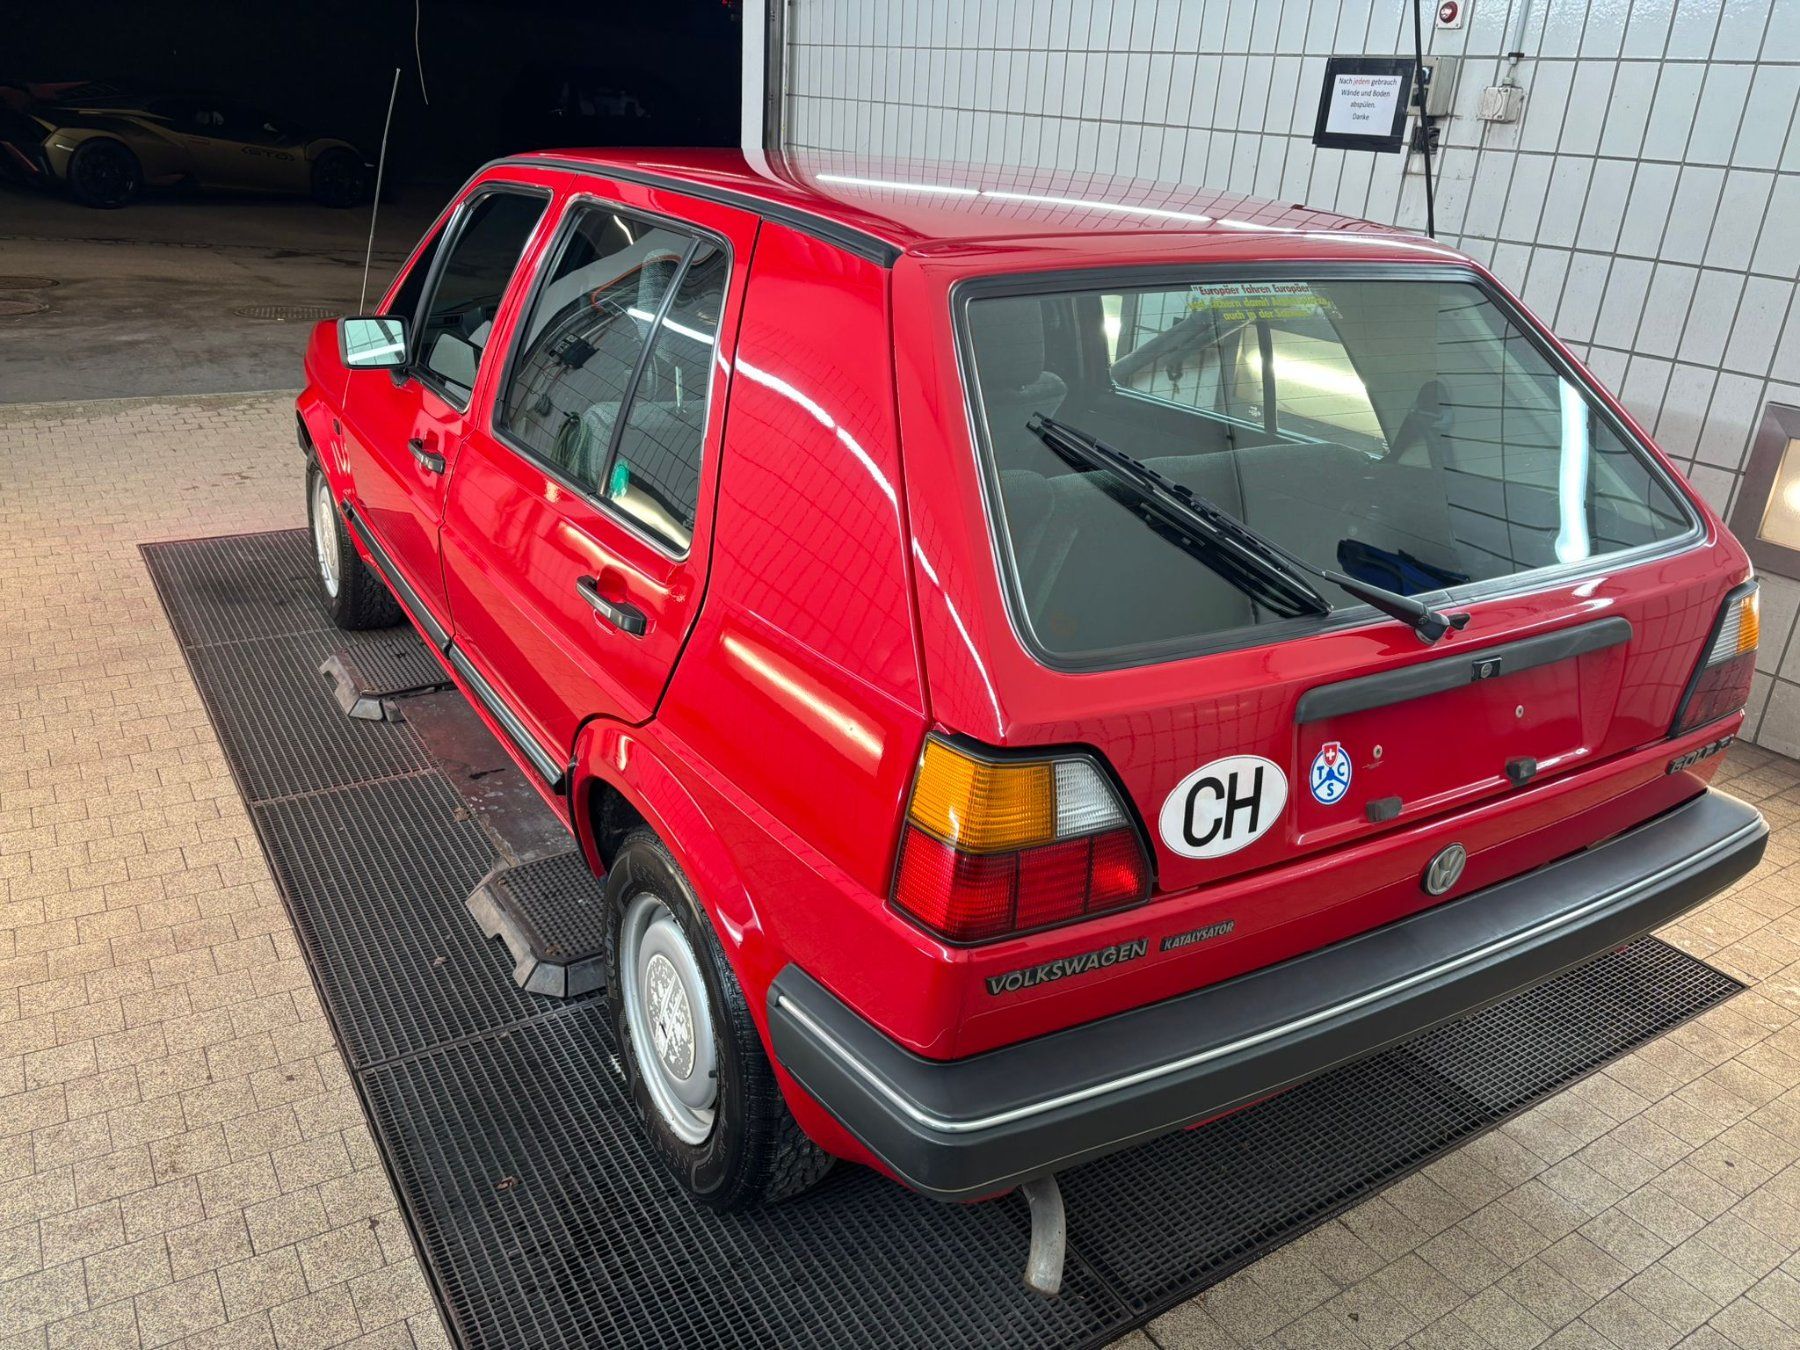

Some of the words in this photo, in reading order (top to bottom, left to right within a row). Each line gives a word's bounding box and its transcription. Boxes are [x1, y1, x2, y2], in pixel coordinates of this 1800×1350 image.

[1338, 77, 1353, 85] Nach
[1352, 78, 1371, 86] jedem
[1371, 78, 1398, 87] gebrauch
[1372, 90, 1391, 98] Boden
[1350, 100, 1376, 109] abspülen.
[1352, 113, 1370, 121] Danke
[1241, 284, 1272, 295] fahren
[1183, 766, 1264, 848] CH
[986, 939, 1149, 996] VOLKSWAGEN
[1162, 920, 1235, 951] KATALYSATOR
